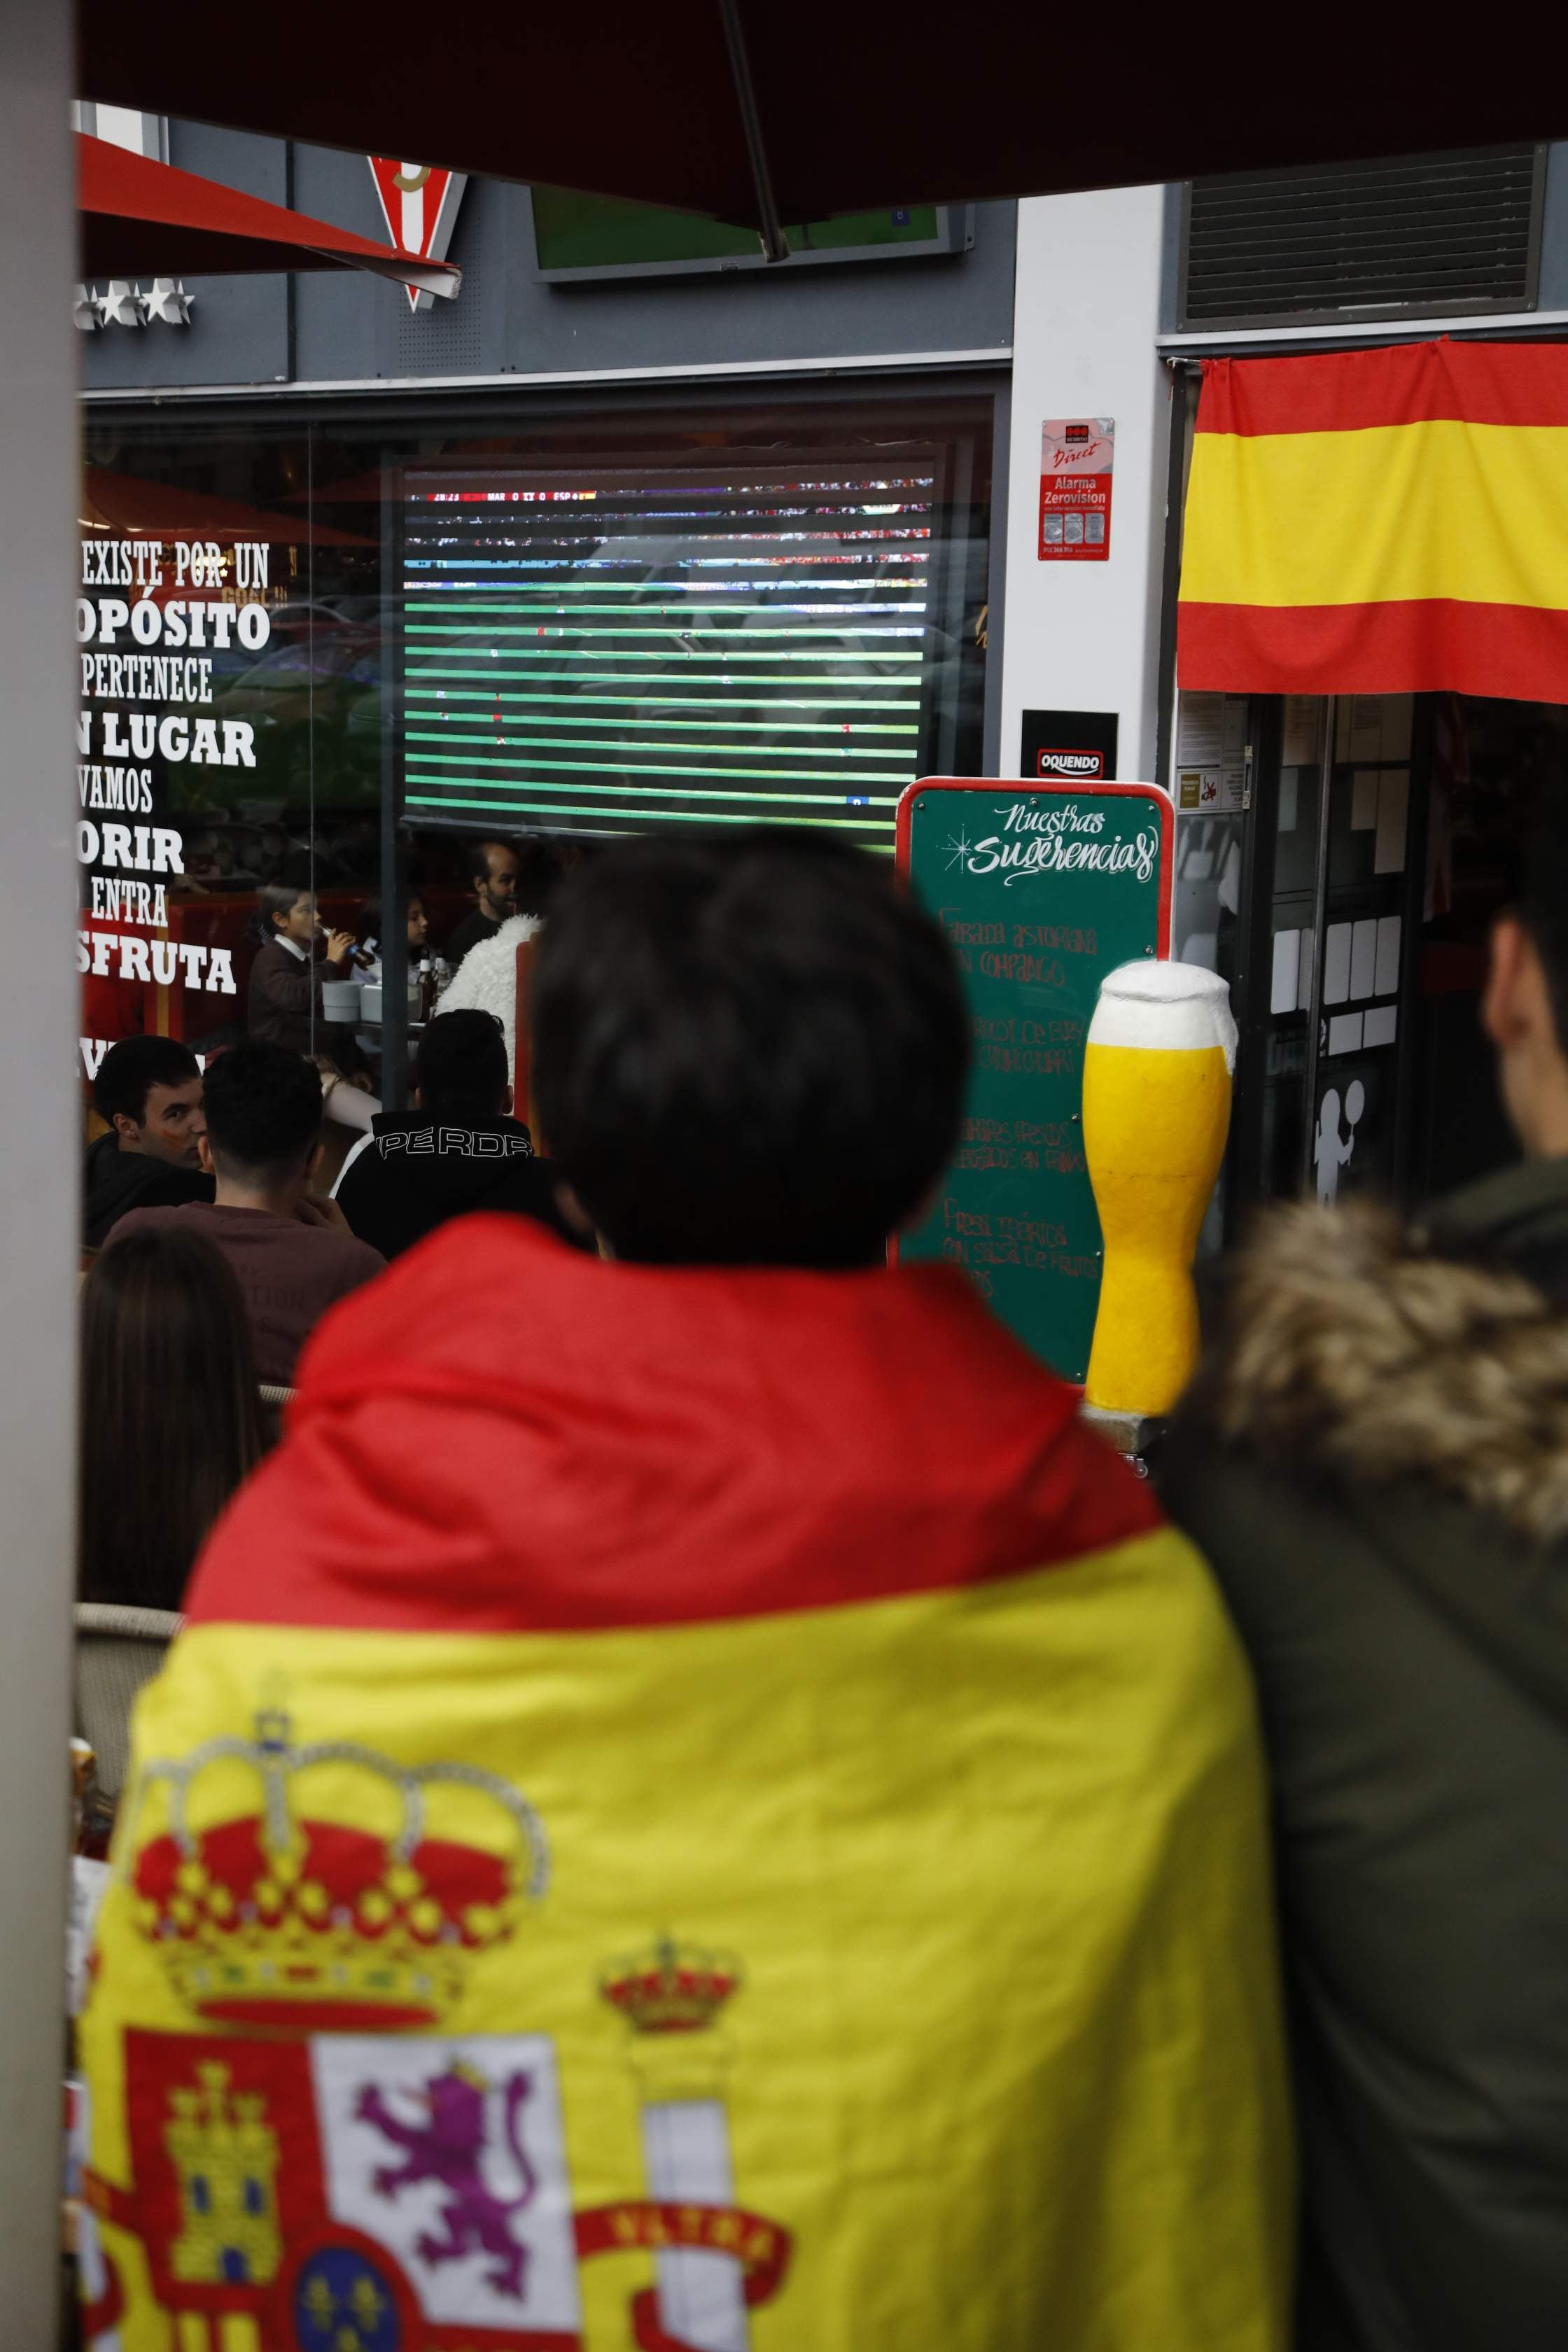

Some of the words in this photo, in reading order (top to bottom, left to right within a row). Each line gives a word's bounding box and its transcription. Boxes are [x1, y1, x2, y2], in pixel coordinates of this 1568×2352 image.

[1053, 441, 1102, 468] Direct
[487, 492, 505, 501] MAR
[1044, 489, 1106, 504] Zerovision
[1055, 477, 1096, 489] Alarma
[81, 540, 162, 586] EXISTE
[175, 541, 223, 587] POR
[234, 542, 270, 589] UN
[81, 653, 212, 703] PERTENECE
[103, 712, 256, 767] LUGAR
[1042, 755, 1099, 771] OQUENDO
[78, 764, 153, 813] VAMOS
[994, 804, 1106, 833] Nuestras
[967, 826, 1158, 886] Sugerencias
[91, 876, 168, 927] ENTRA
[376, 1126, 533, 1161] PERDR
